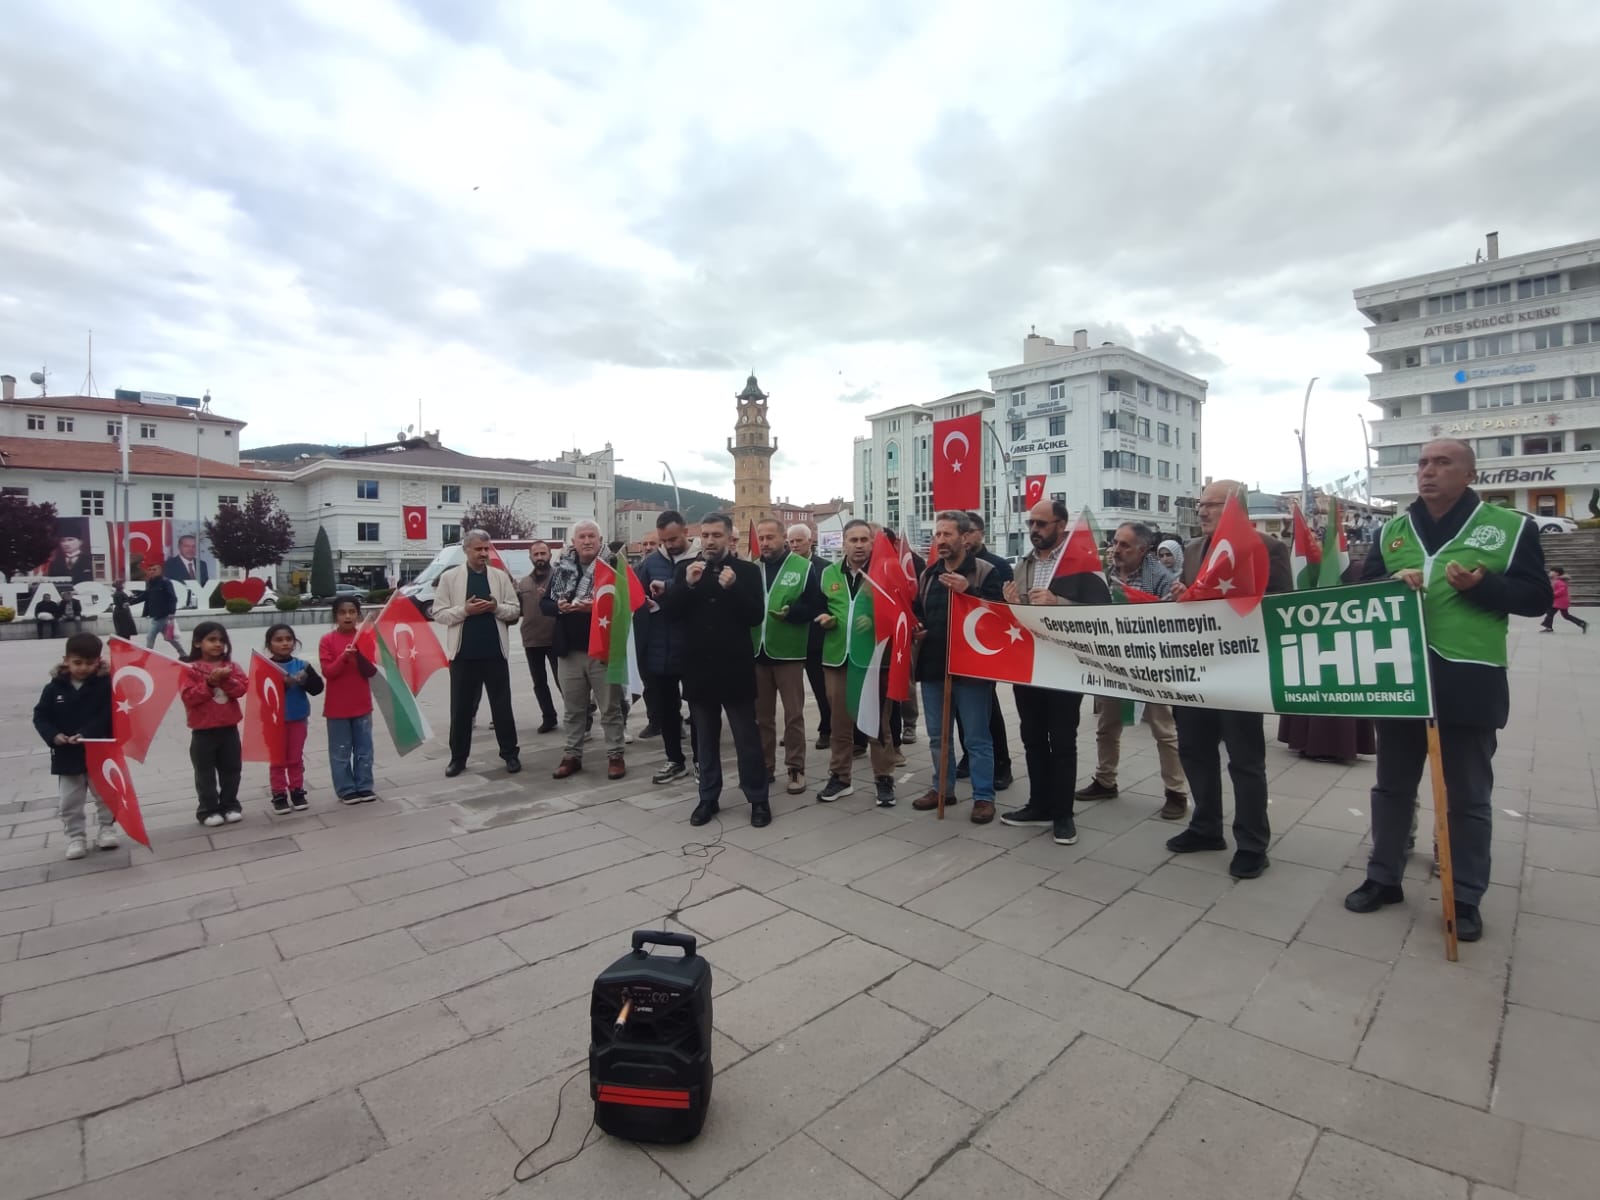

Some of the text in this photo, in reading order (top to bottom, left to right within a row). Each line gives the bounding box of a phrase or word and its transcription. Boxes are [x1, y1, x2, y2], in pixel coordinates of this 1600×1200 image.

[1424, 306, 1561, 337] ATEŞ SÜRÜCÜ KURSU
[1450, 415, 1539, 433] AK PARTİ
[1038, 439, 1069, 451] AÇIKEL
[1276, 596, 1405, 628] YOZGAT
[1115, 613, 1221, 634] hüzünlenmeyin.
[1094, 640, 1122, 658] iman
[1124, 641, 1157, 660] etmiş
[1159, 640, 1215, 659] kimseler
[1218, 635, 1260, 656] iseniz
[1285, 690, 1415, 702] İNSANİ YARDIM DERNEĞİ
